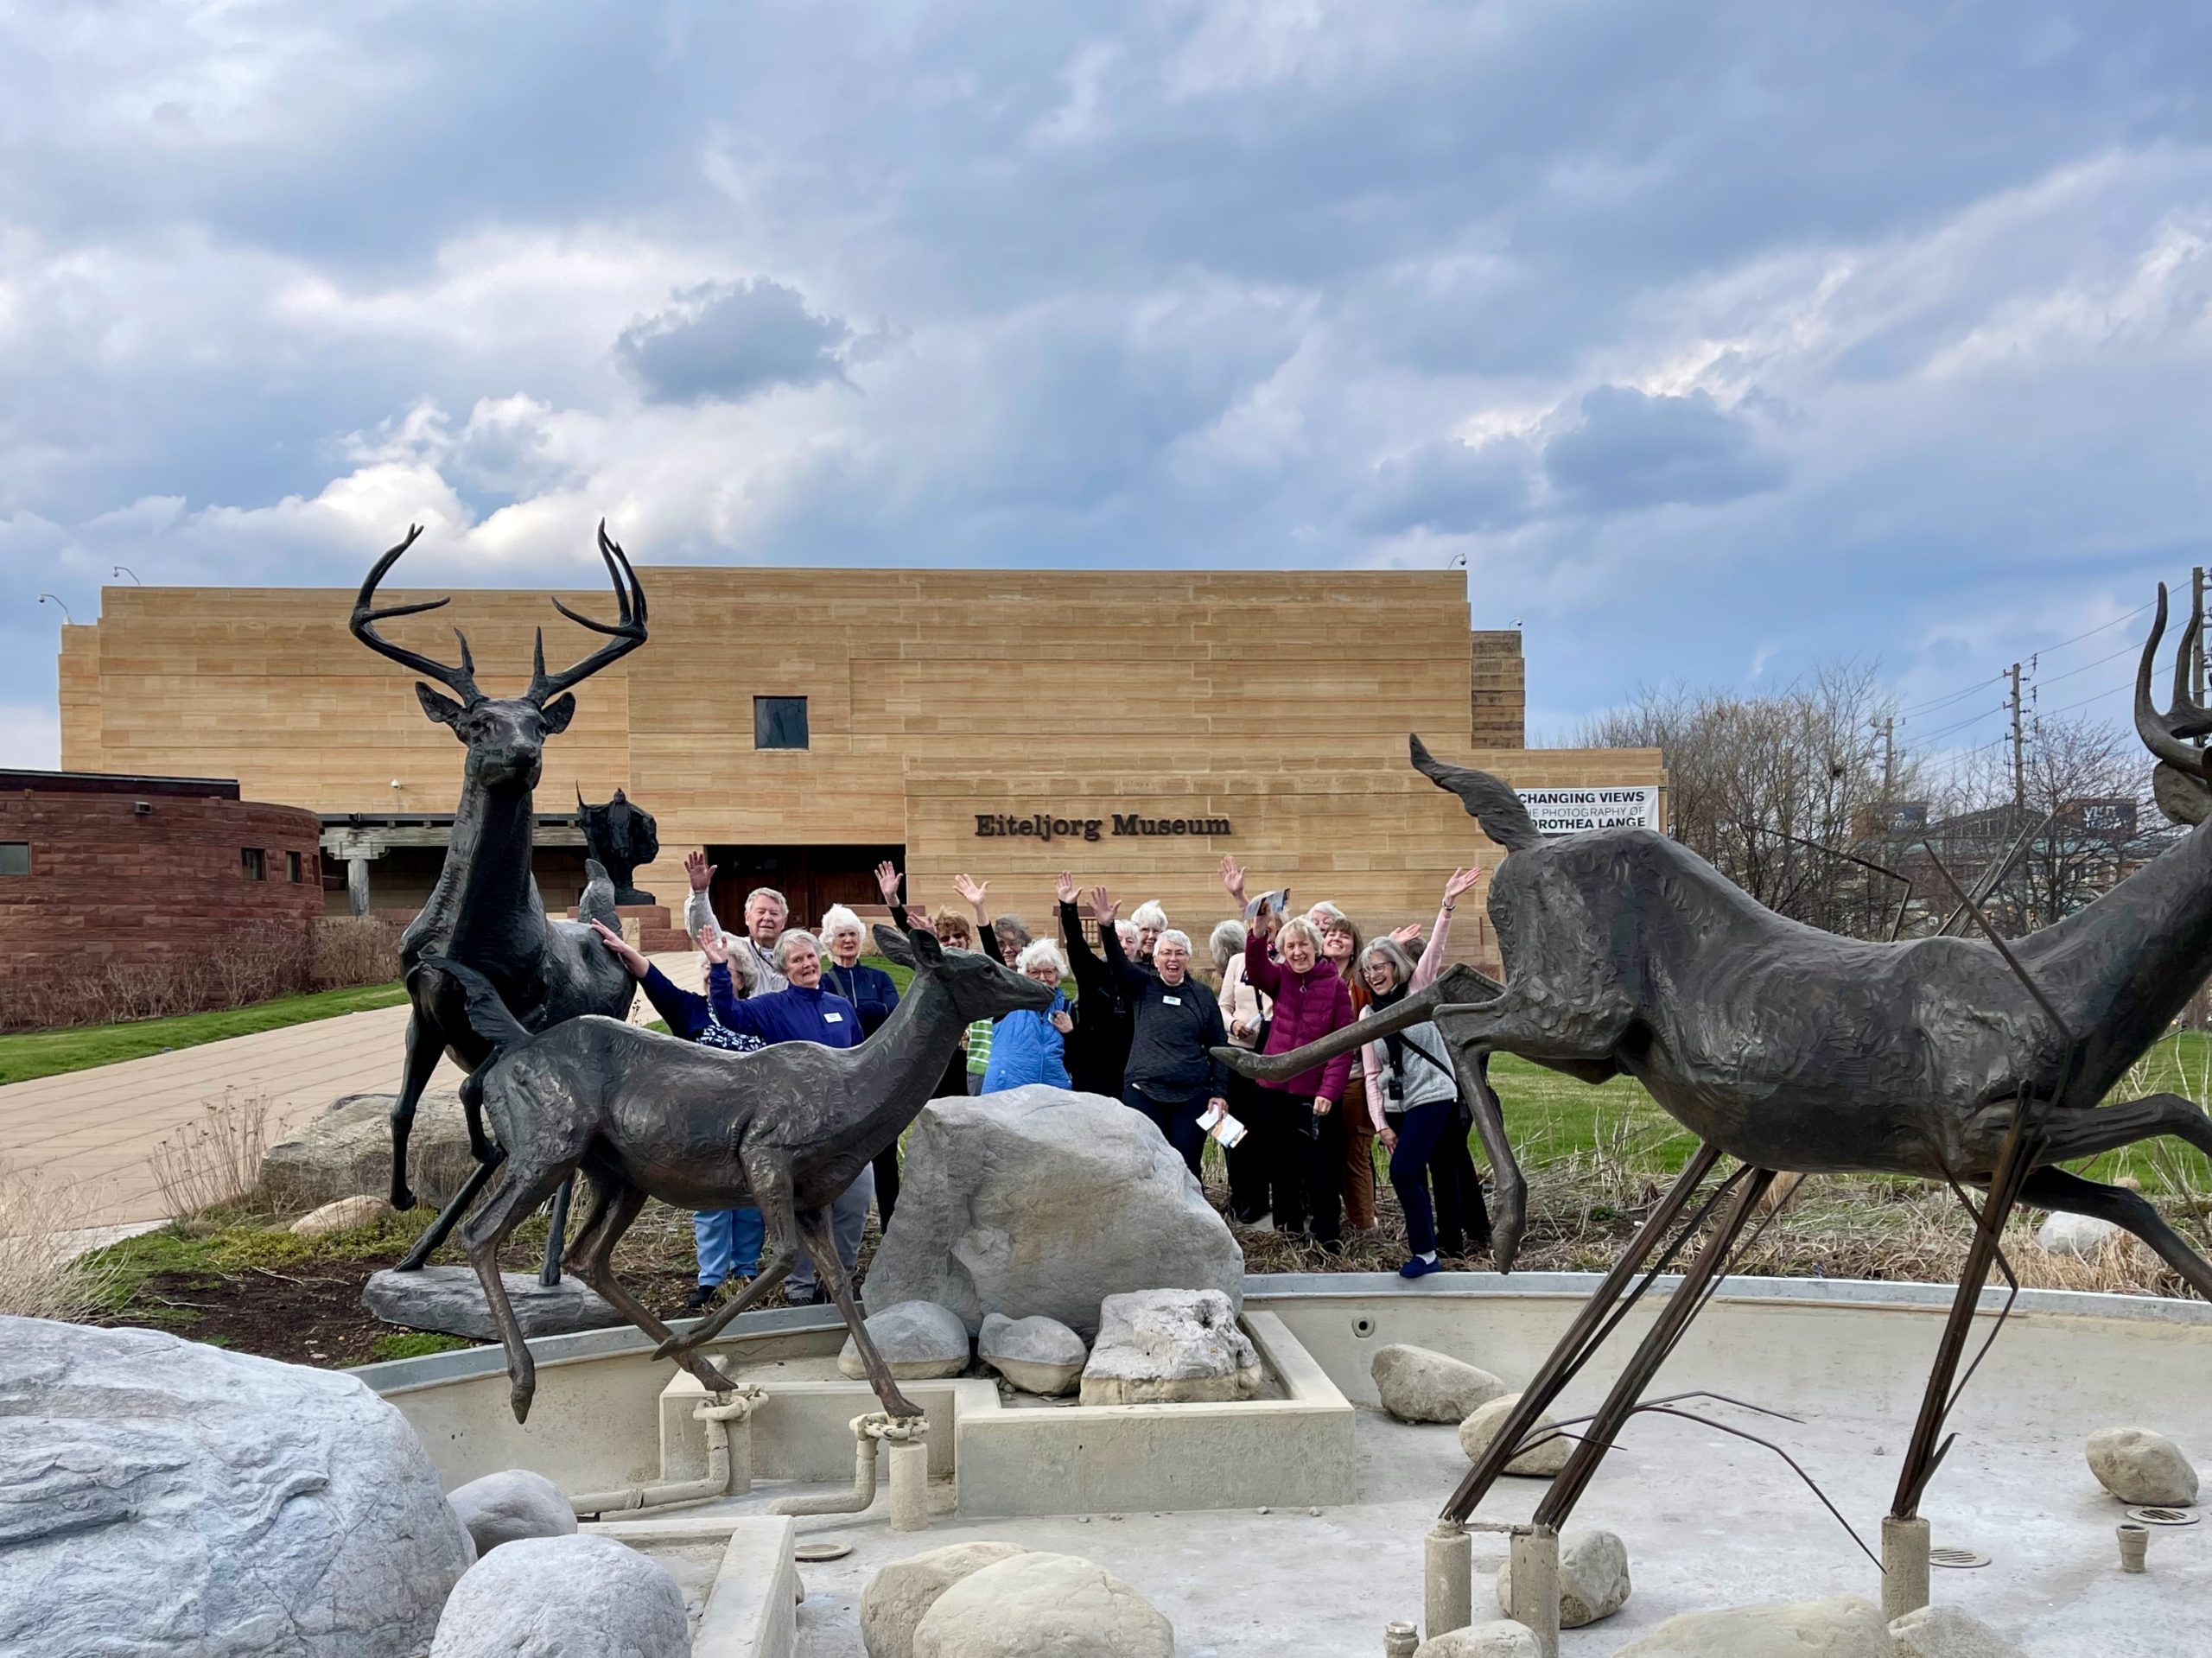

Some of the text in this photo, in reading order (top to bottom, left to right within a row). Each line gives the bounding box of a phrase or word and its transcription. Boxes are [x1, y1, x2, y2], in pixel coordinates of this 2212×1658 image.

[1518, 791, 1645, 804] CHANGING VIEWS
[1541, 807, 1626, 817] PHOTOGRAPHY
[1630, 806, 1645, 816] OF
[975, 814, 1231, 841] Eiteljorg Museum
[1531, 816, 1646, 829] OROTHEA LANGE
